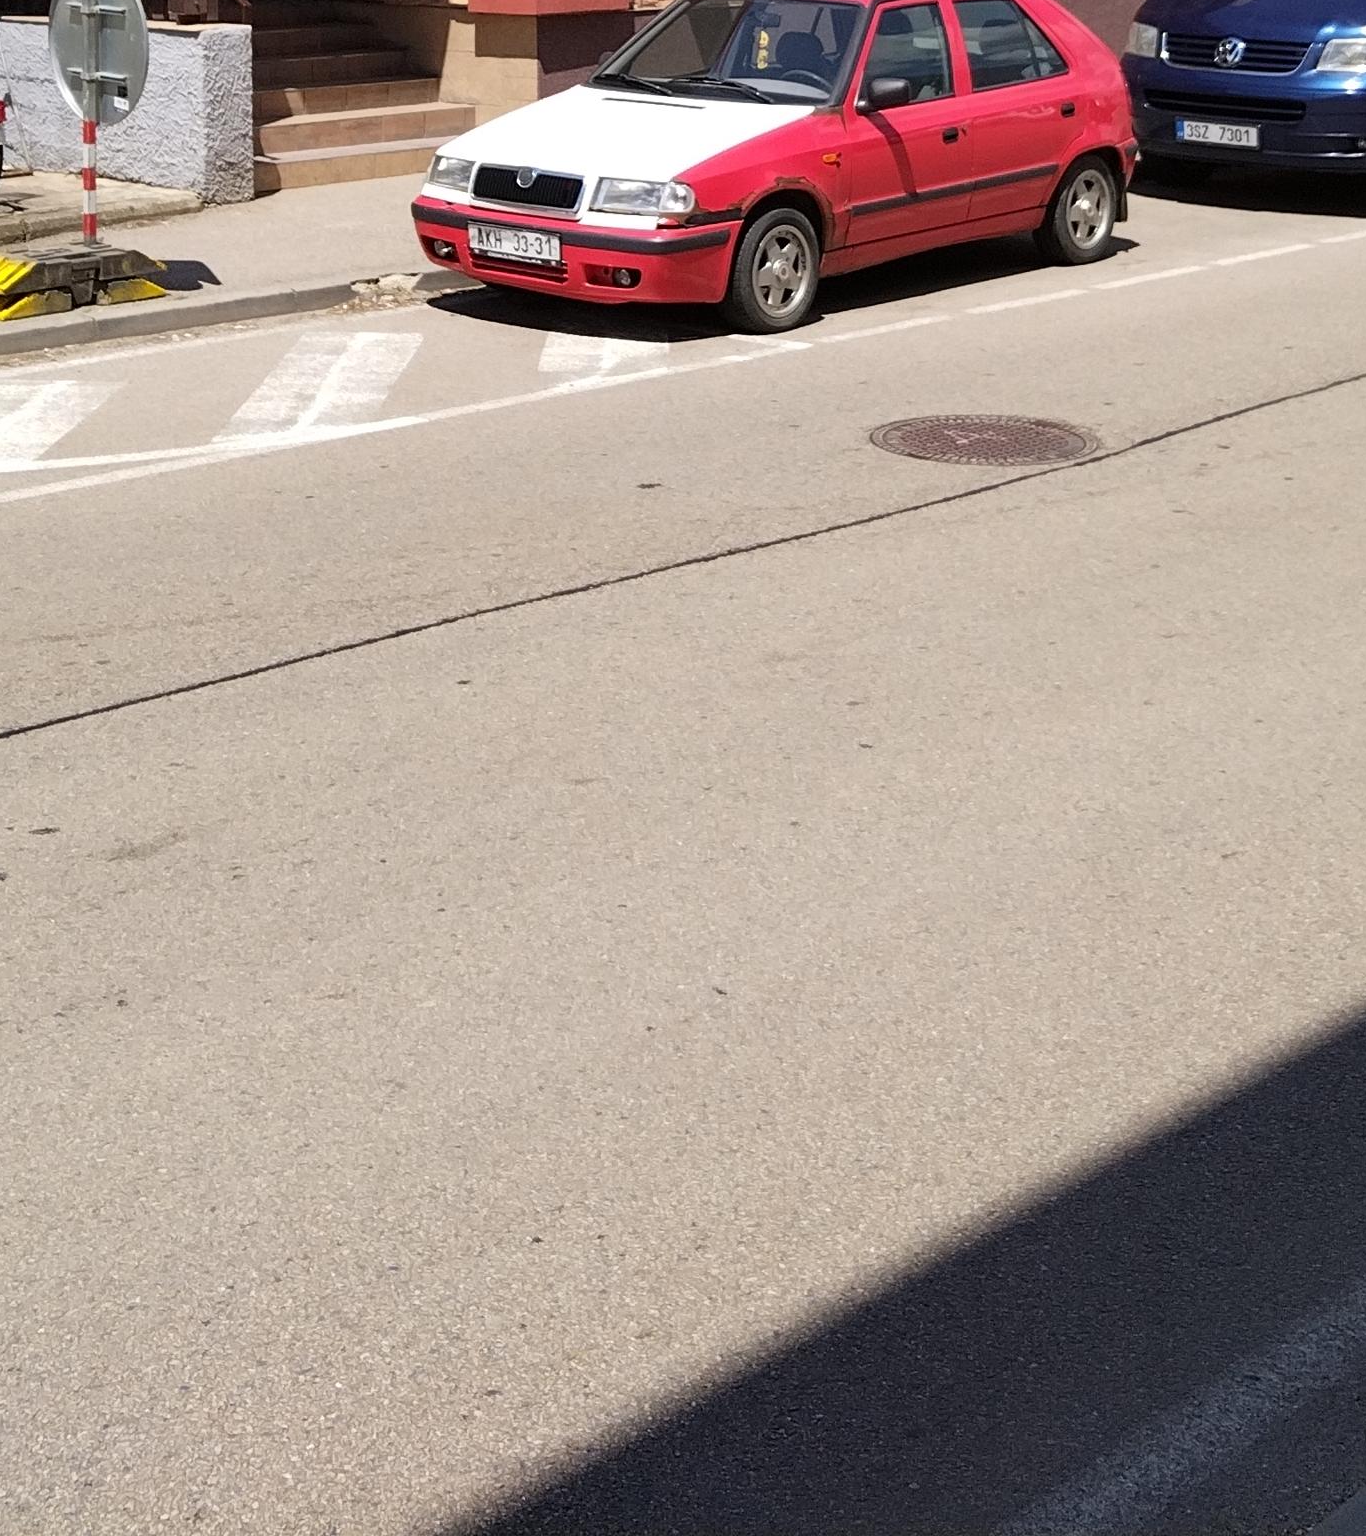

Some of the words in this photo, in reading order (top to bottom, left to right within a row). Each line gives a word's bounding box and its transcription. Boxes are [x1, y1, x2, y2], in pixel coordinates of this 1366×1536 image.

[1186, 123, 1209, 139] 3SZ
[1219, 125, 1250, 143] 7301
[477, 227, 503, 250] AKH
[513, 233, 553, 257] 33-31
